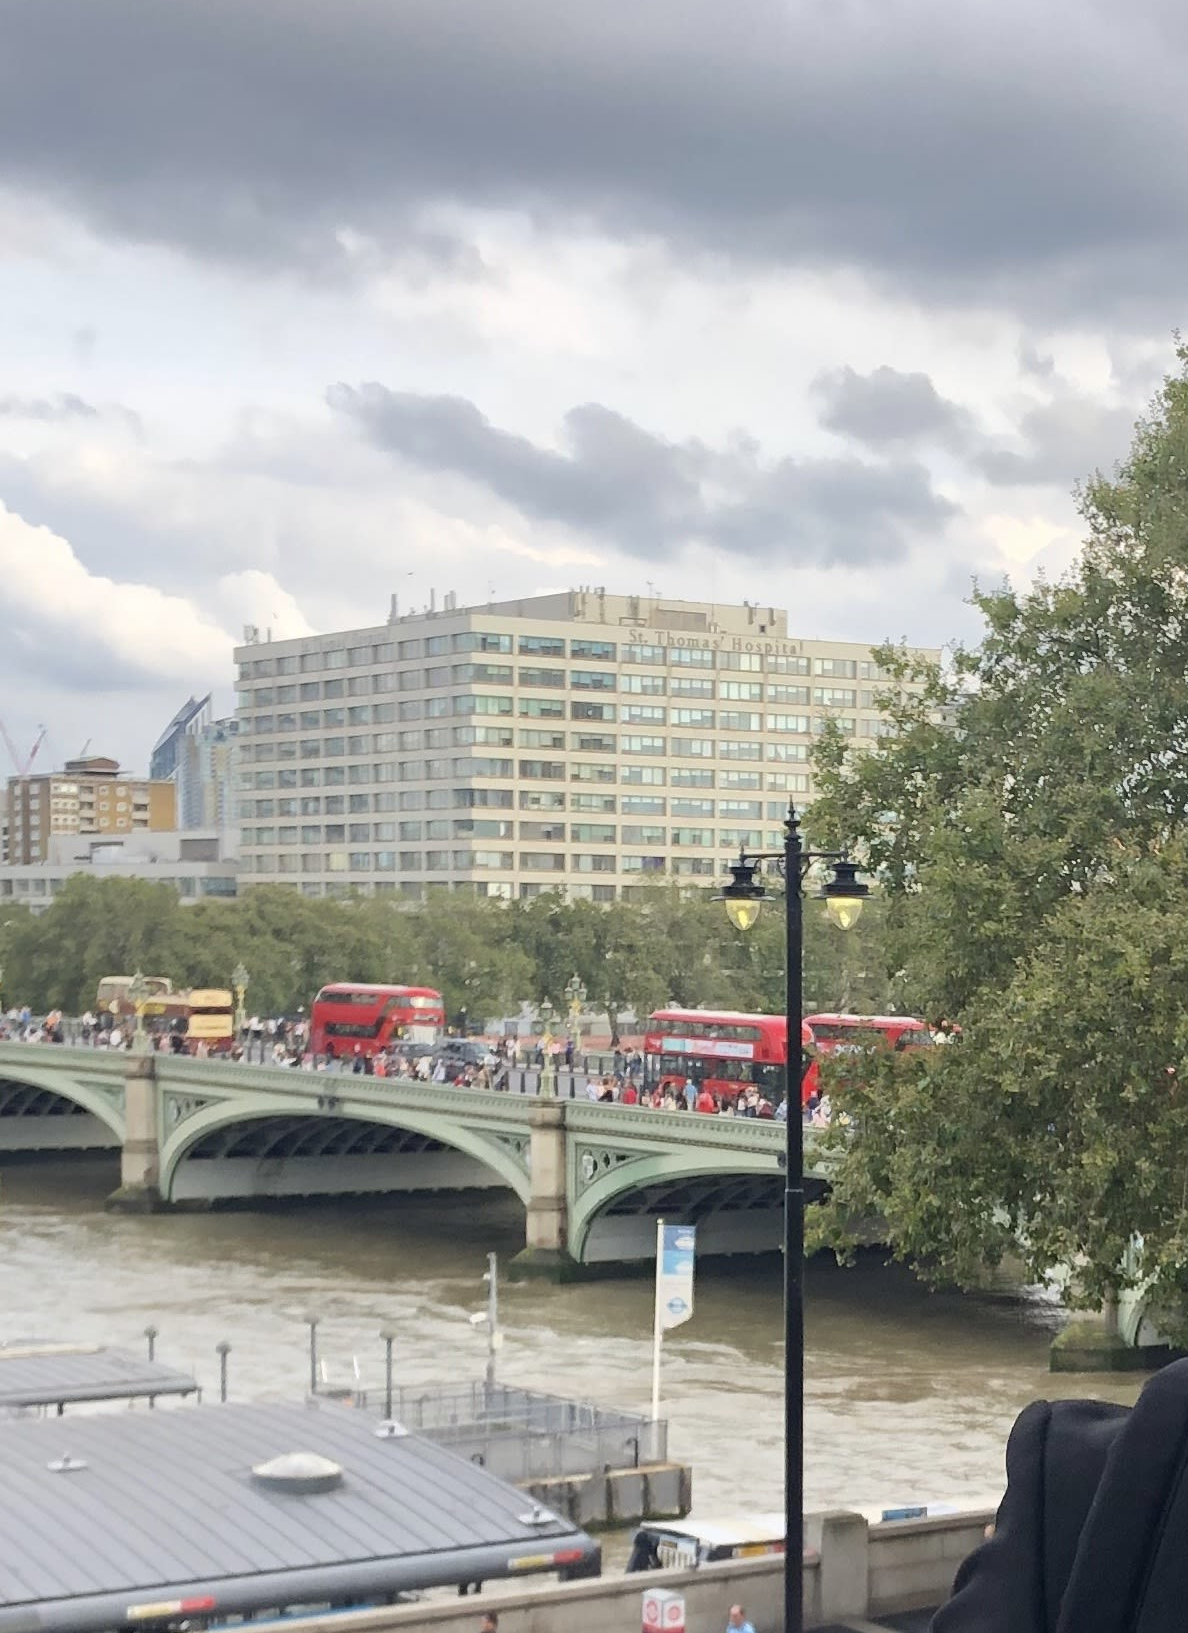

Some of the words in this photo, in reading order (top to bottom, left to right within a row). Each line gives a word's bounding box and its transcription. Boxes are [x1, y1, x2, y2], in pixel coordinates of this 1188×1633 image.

[628, 629, 648, 644] St.
[655, 631, 724, 650] Thomas'
[732, 637, 804, 655] Hospital
